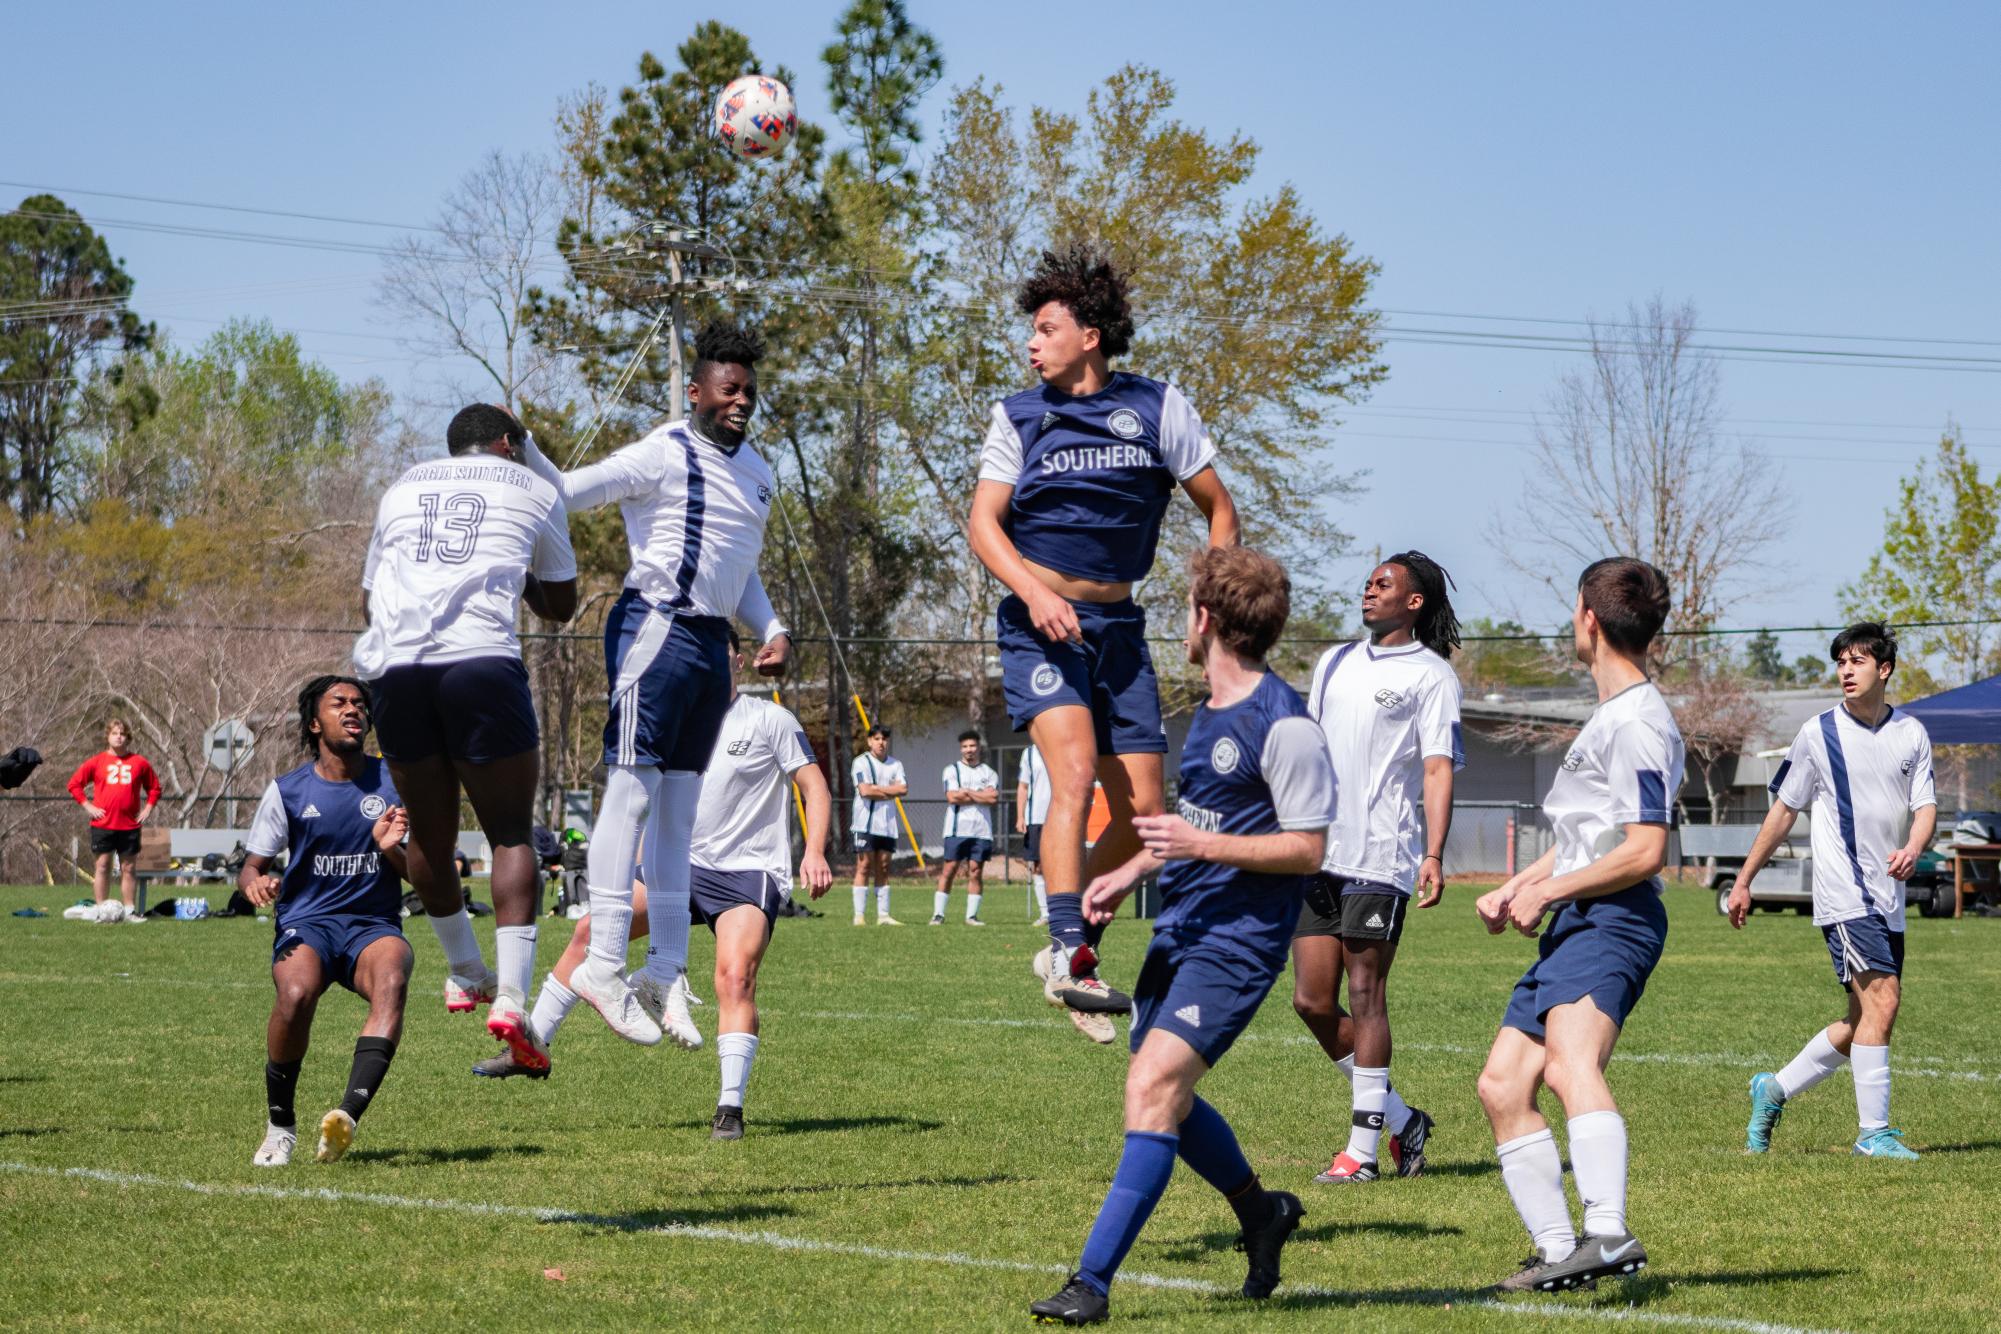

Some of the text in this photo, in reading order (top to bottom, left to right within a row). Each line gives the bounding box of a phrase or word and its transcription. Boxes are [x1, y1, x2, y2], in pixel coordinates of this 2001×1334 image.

[1042, 445, 1152, 474] SOUTHERN
[417, 493, 487, 564] 13
[107, 765, 132, 785] 25
[314, 851, 382, 877] SOUTHERN
